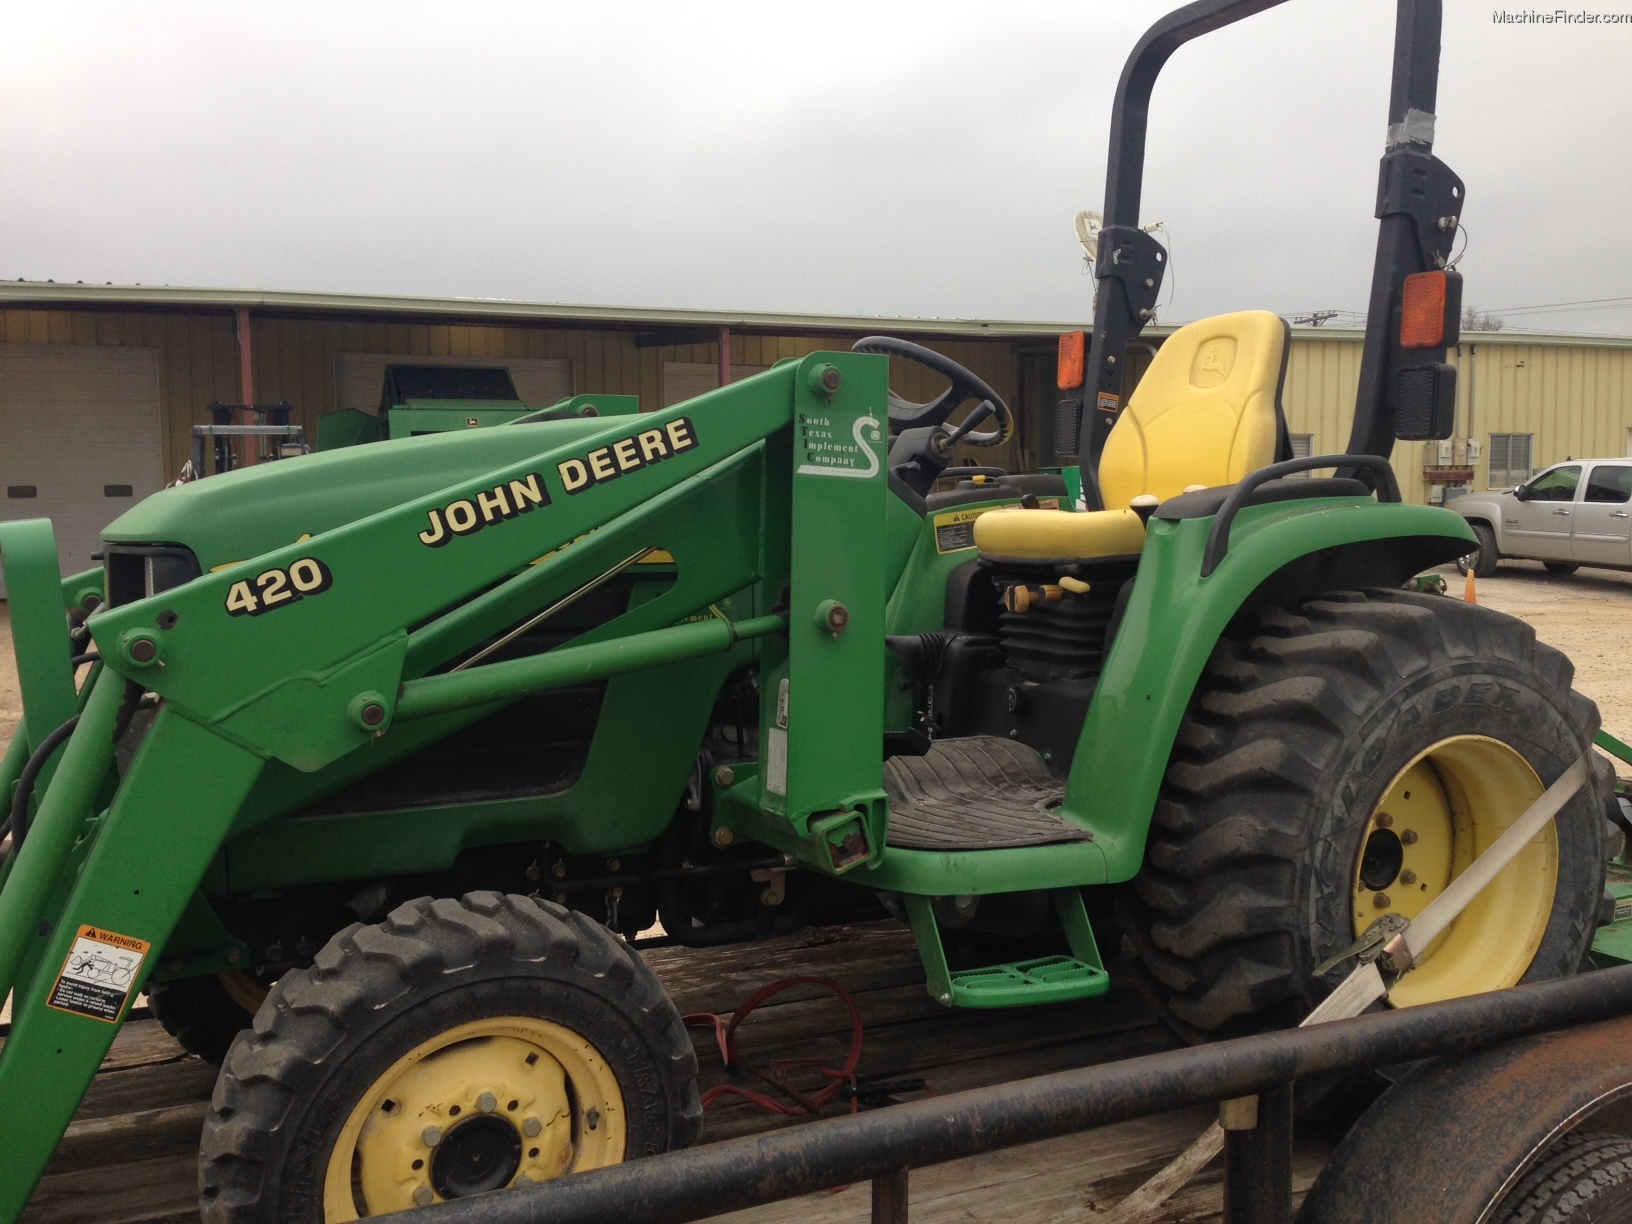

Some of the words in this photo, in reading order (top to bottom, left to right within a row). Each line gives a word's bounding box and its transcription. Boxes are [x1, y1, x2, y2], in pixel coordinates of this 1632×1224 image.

[799, 414, 830, 426] South
[801, 426, 833, 438] Texas
[804, 439, 858, 453] Implement
[807, 452, 855, 467] Company
[418, 473, 550, 546] JOHN
[556, 417, 698, 494] DEERE
[225, 557, 332, 616] 420
[99, 932, 142, 950] WARNING
